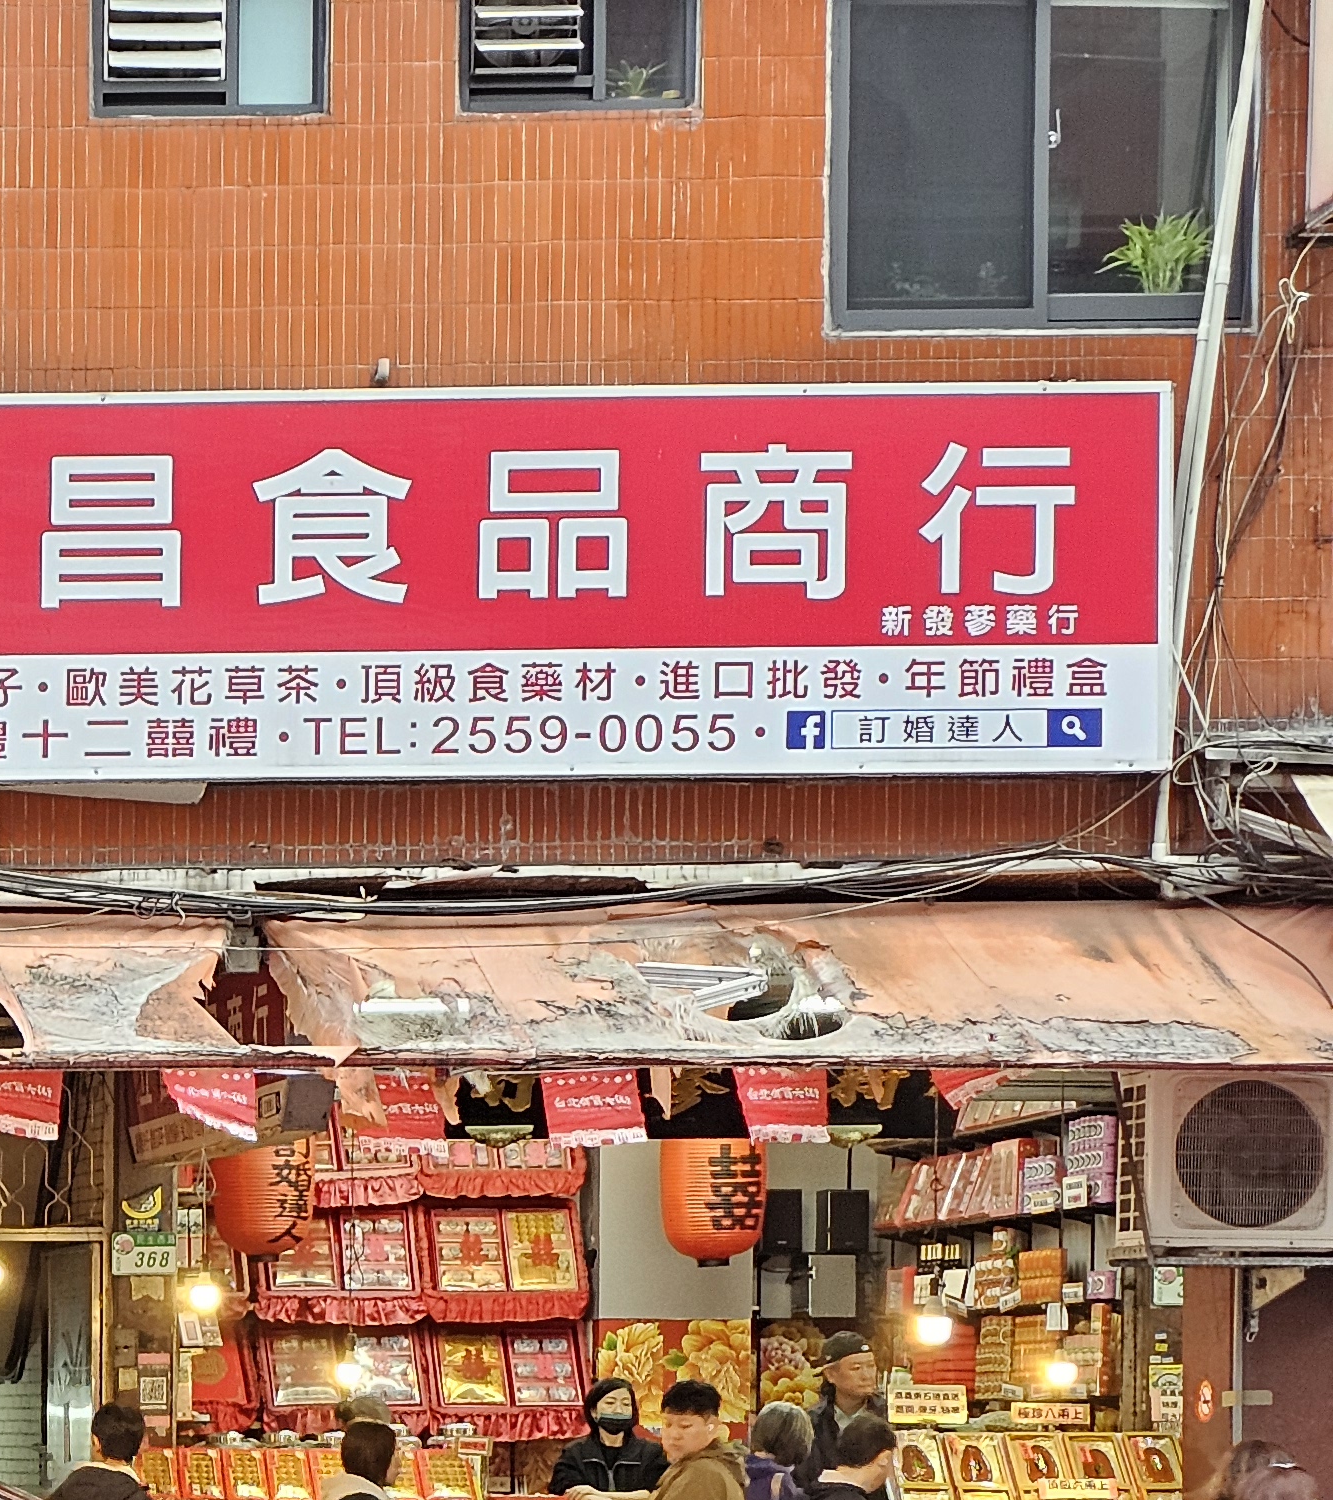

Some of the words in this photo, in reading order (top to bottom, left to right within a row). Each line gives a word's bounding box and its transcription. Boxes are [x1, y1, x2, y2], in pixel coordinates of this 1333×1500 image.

[858, 715, 1024, 745] 訂婚達人
[134, 1250, 170, 1268] 368
